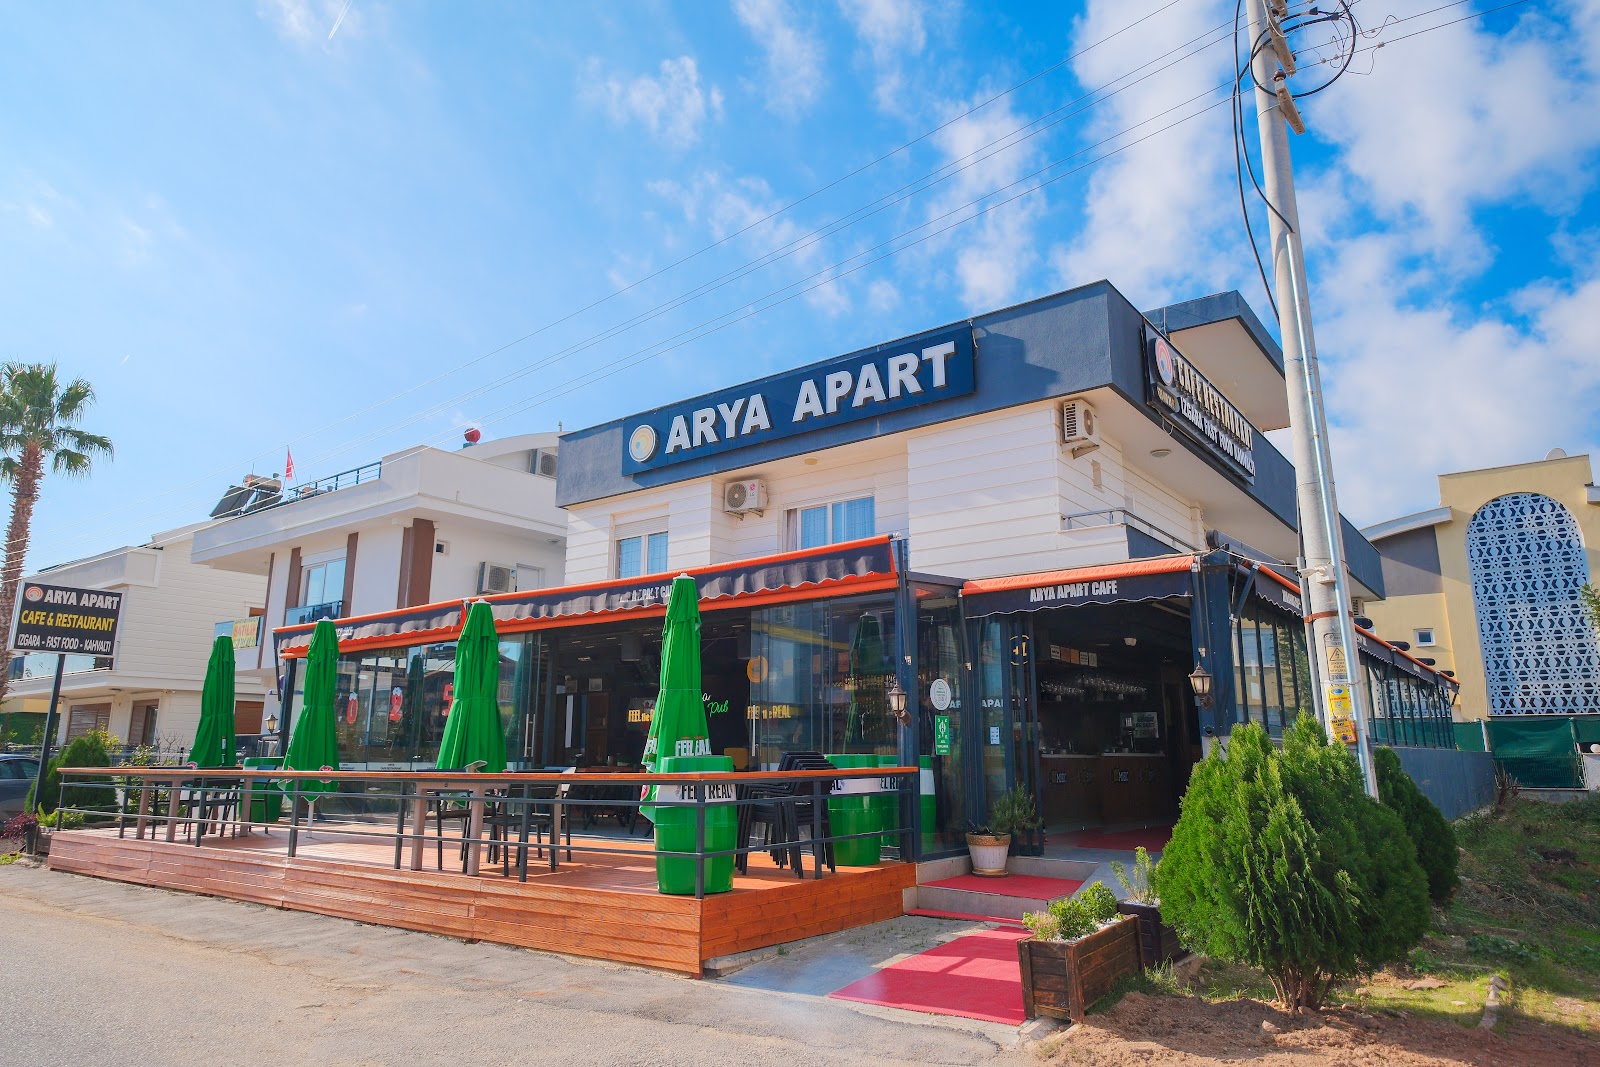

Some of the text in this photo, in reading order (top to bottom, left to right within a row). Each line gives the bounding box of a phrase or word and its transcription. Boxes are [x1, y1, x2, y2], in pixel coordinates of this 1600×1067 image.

[665, 341, 955, 454] ARYA APART
[44, 589, 120, 610] ARYA APART
[1030, 580, 1118, 602] ARYA APART CAFE
[21, 610, 115, 632] CAFE & RESTAURANT
[46, 636, 60, 649] FAST
[61, 637, 79, 650] FOOD
[84, 639, 112, 653] KAHVALTI
[628, 709, 642, 722] FEEL
[773, 705, 791, 719] REAL
[709, 785, 732, 799] REAL
